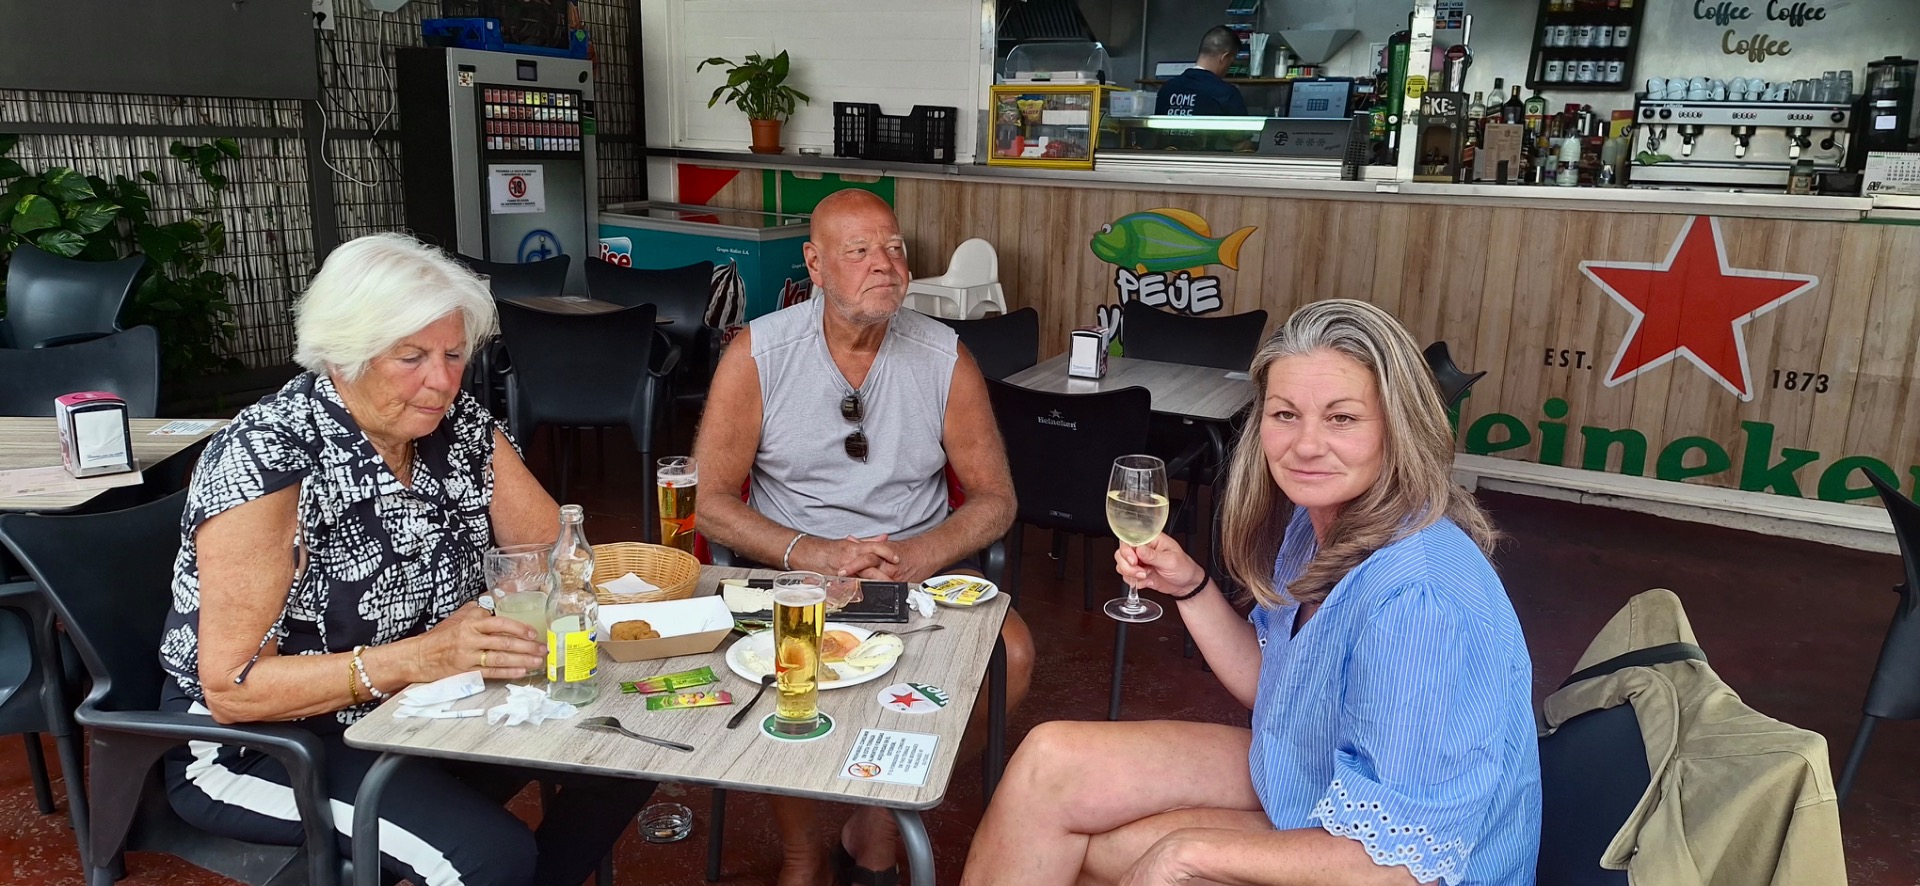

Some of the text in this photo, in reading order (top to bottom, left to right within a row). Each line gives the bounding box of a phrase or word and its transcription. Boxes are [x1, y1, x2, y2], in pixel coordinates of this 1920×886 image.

[1694, 0, 1827, 27] Coffee Coffee
[1722, 29, 1792, 63] Coffee
[1169, 93, 1197, 107] COME
[1116, 268, 1221, 314] PEJE
[1544, 347, 1593, 371] EST.
[1771, 368, 1830, 394] 1873
[1037, 416, 1077, 430] Heineken
[1448, 388, 1920, 506] eineke
